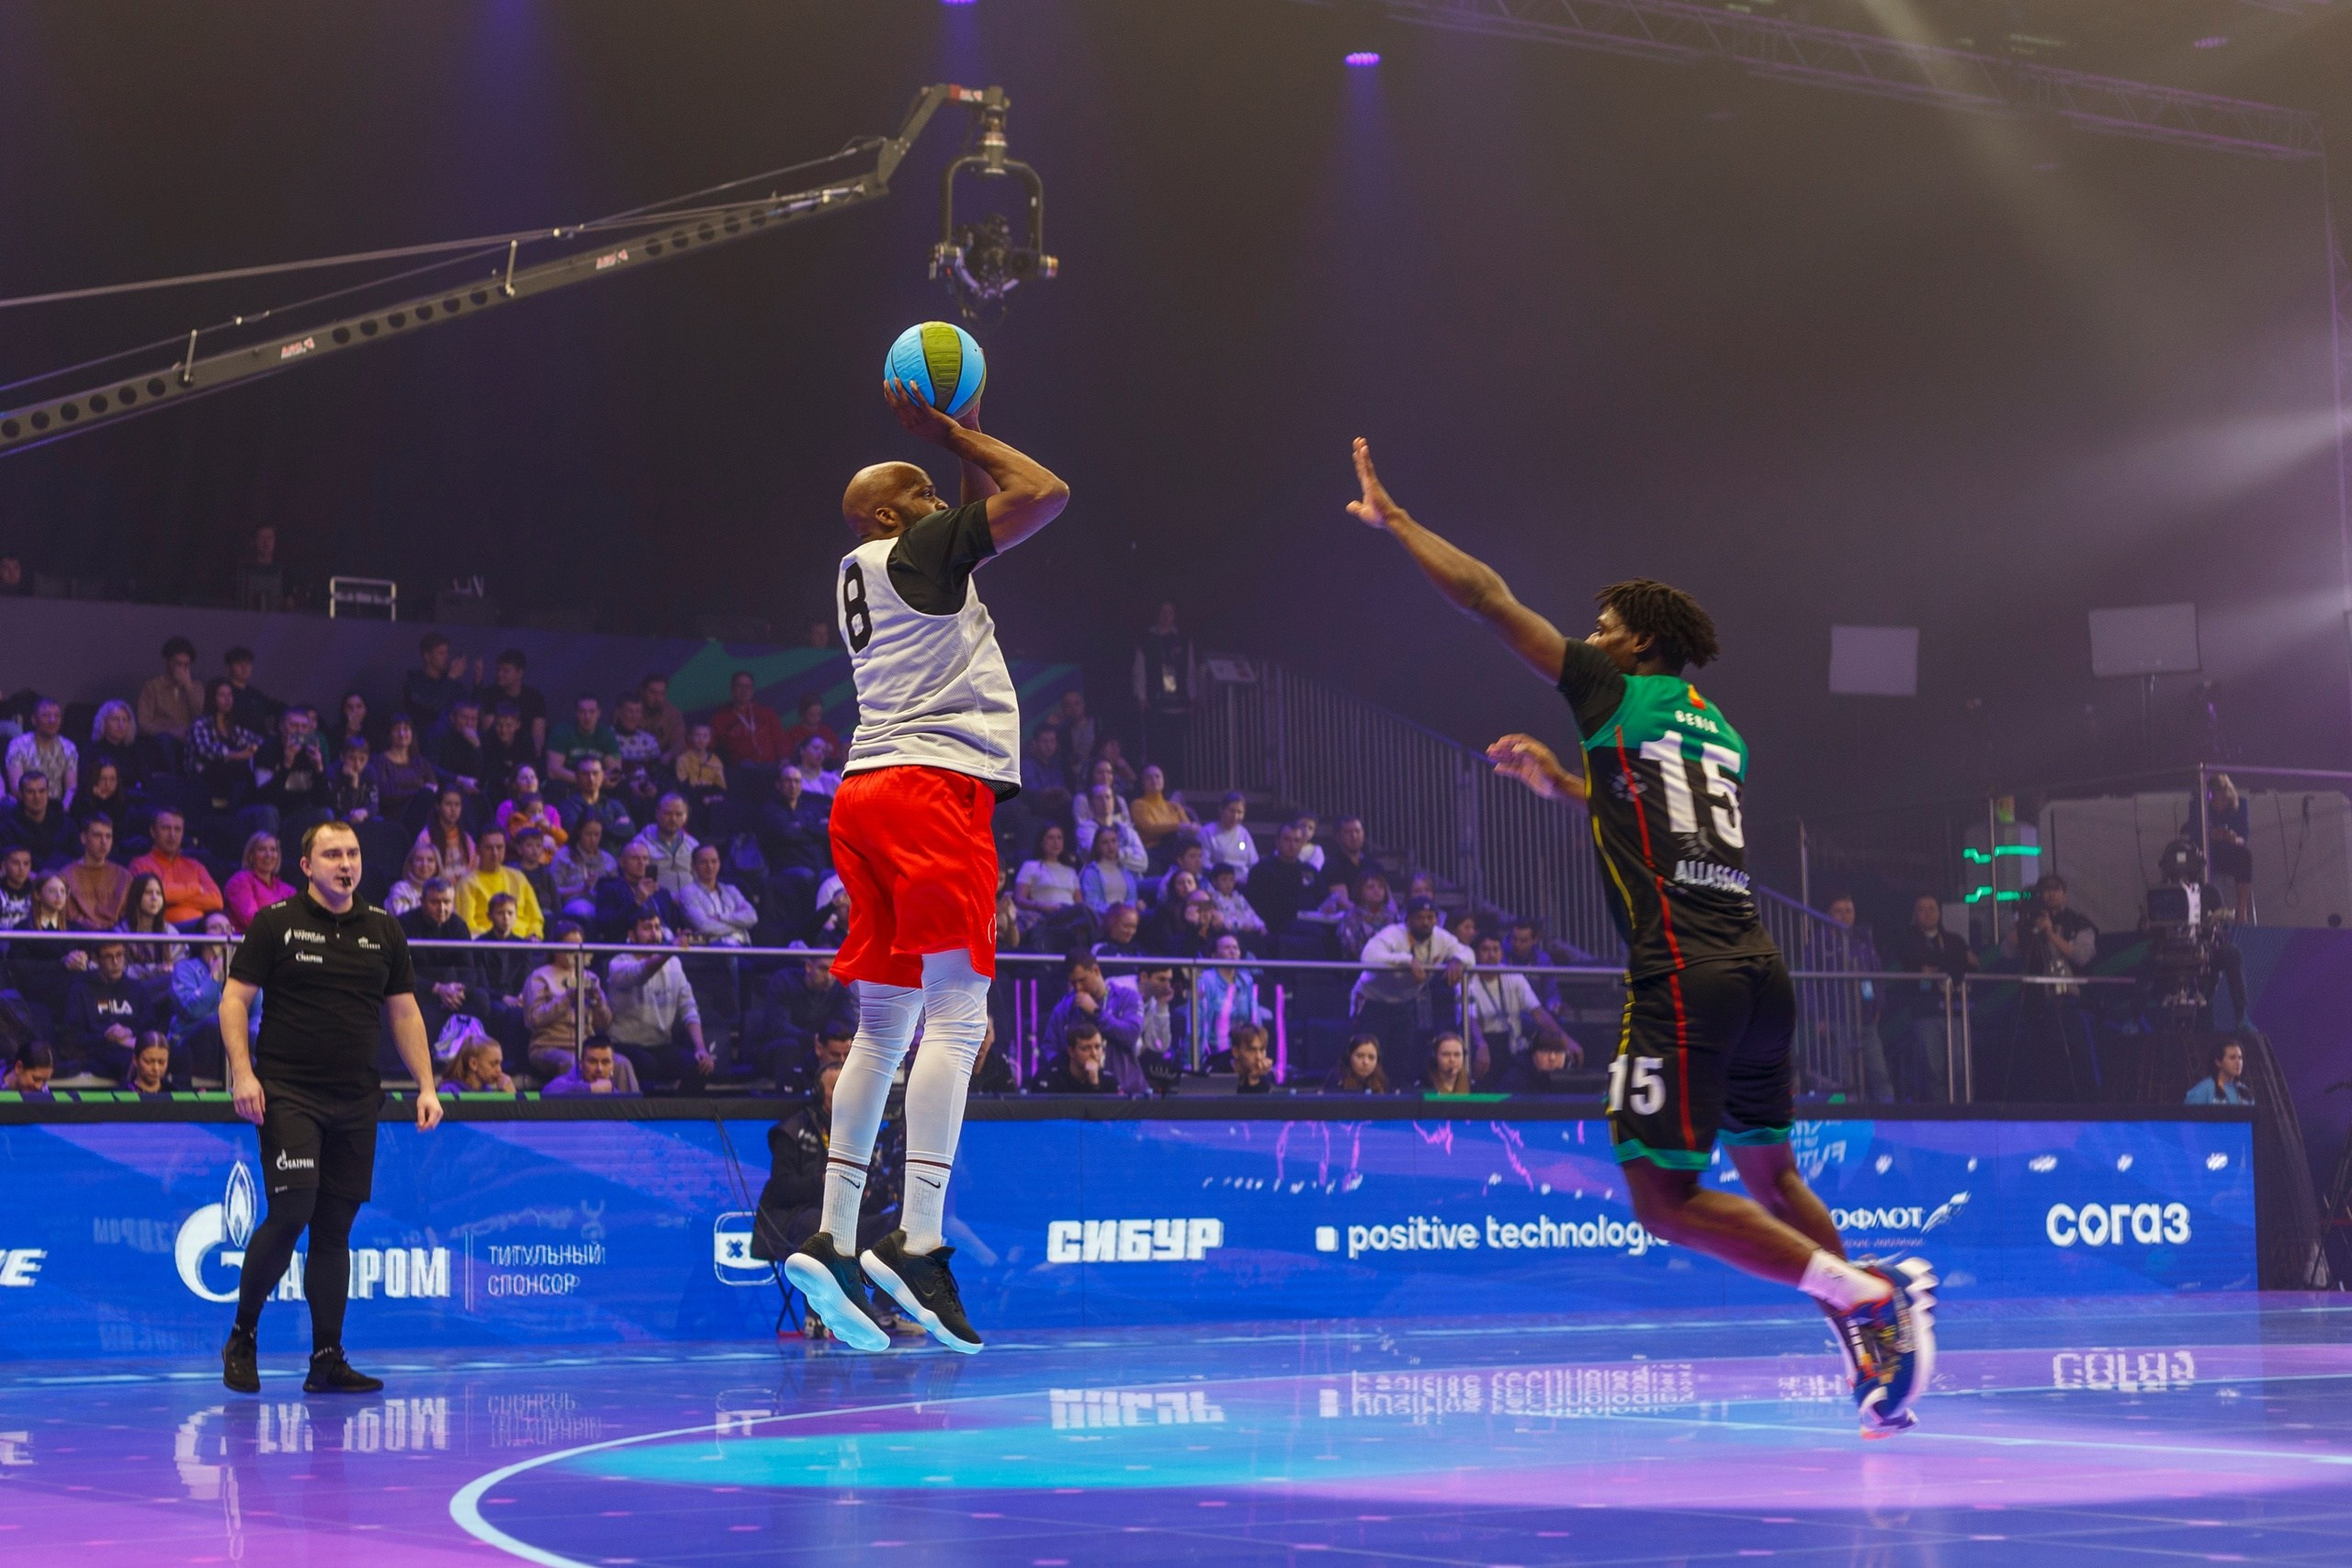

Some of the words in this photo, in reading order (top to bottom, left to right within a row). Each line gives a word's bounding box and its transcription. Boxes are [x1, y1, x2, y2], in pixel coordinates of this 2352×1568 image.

[843, 561, 873, 654] 8
[1640, 730, 1745, 848] 15
[97, 999, 133, 1015] FILA
[1608, 1054, 1666, 1115] 15
[1348, 1215, 1480, 1259] positive
[1486, 1213, 1670, 1256] technolog
[1831, 1207, 1926, 1230] ОФЛОТ
[488, 1240, 606, 1267] ТИТУЛЬНЫЙ
[1046, 1218, 1224, 1263] СИБУР
[0, 1247, 48, 1287] E
[488, 1273, 581, 1297] СПОНСОР
